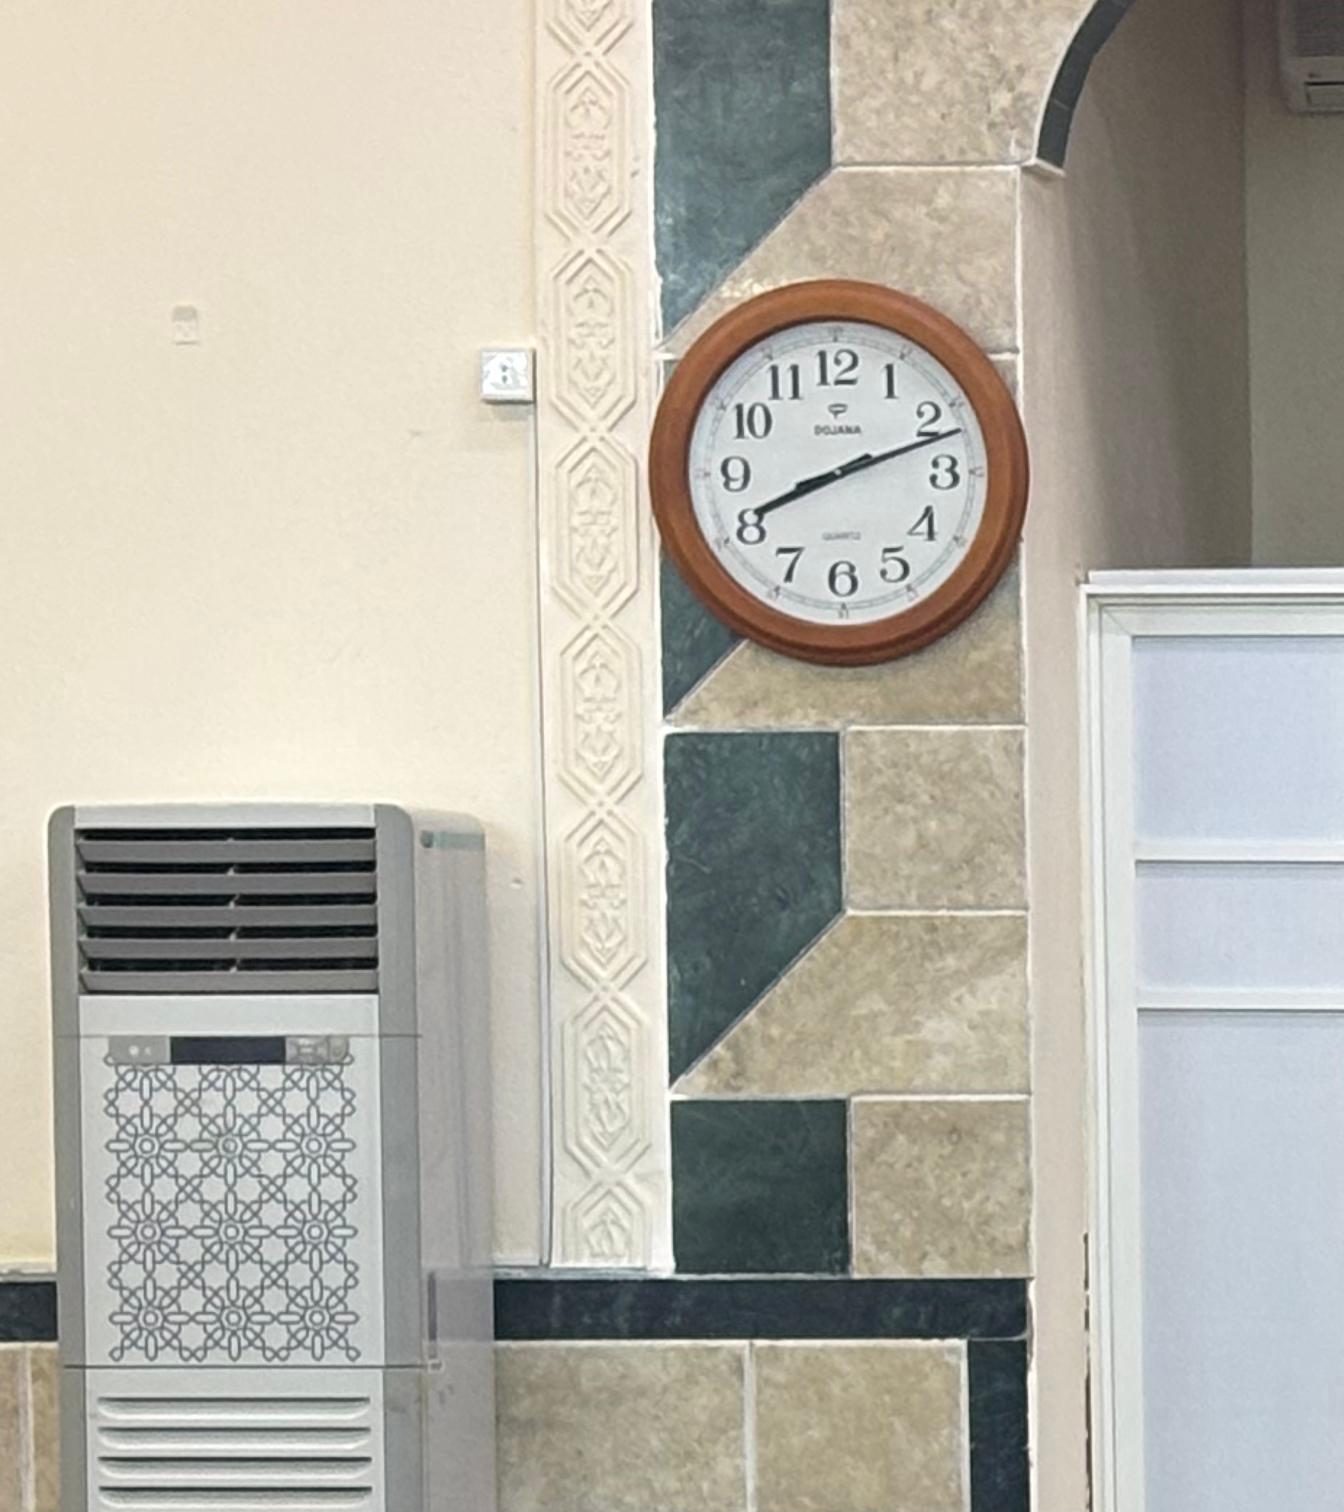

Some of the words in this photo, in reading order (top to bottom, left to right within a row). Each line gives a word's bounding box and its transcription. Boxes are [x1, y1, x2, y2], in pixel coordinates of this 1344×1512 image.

[768, 363, 804, 401] 11
[816, 349, 859, 387] 12
[881, 362, 899, 400] 1
[734, 402, 773, 440] 10
[916, 400, 942, 438] 2
[720, 455, 752, 493] 9
[929, 453, 961, 491] 3
[736, 508, 767, 546] 8
[907, 504, 938, 542] 4
[775, 546, 806, 584] 7
[828, 560, 859, 598] 6
[880, 546, 911, 584] 5
